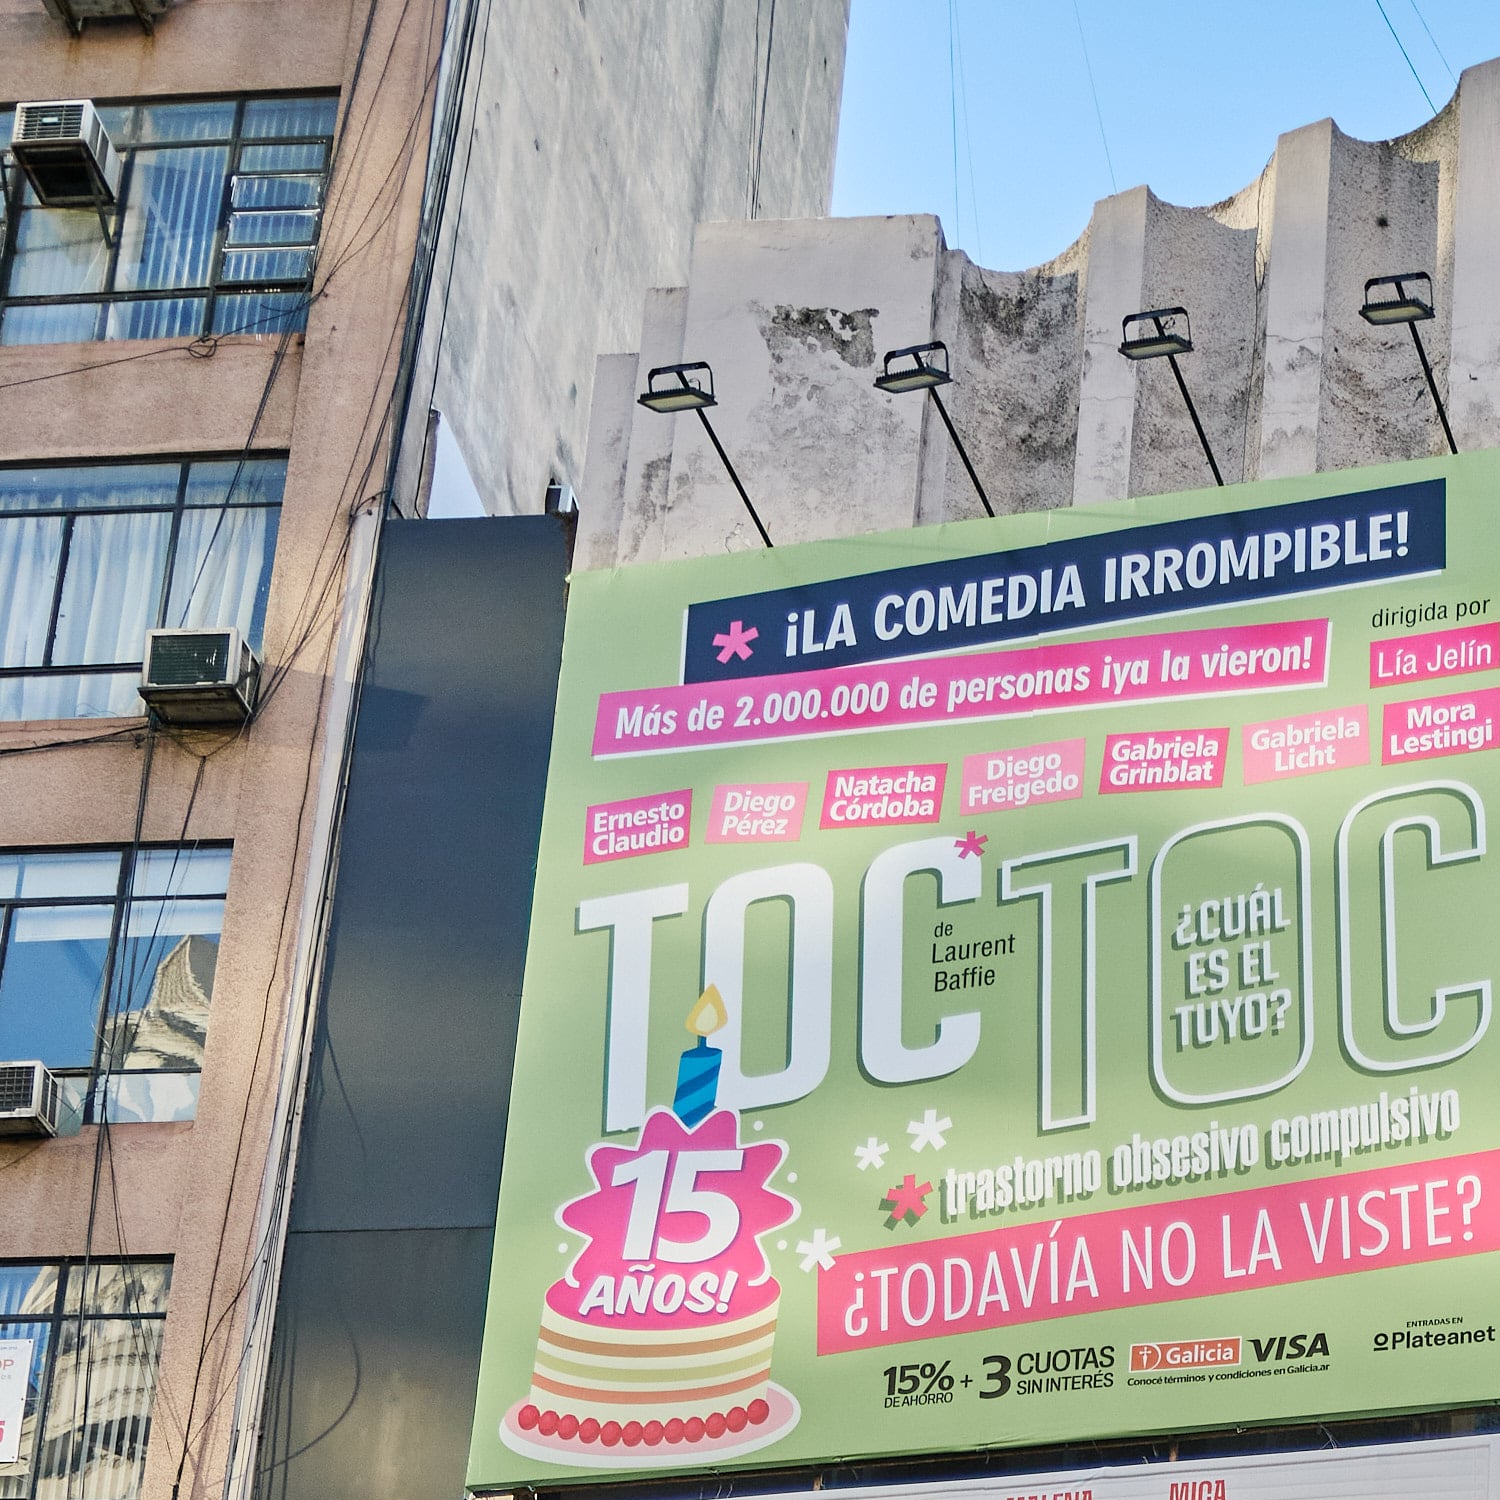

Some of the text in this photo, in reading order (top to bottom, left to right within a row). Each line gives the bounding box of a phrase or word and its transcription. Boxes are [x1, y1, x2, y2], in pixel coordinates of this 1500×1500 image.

[785, 512, 1410, 658] ¡LA COMEDIA IRROMPIBLE!
[1371, 600, 1490, 628] dirigida por
[1378, 639, 1492, 678] Lía Jelín
[615, 637, 1311, 739] Más de 2.000.000 de personas ¡ya la vieron!
[1407, 703, 1476, 729] Mora
[1111, 737, 1218, 760] Gabriela
[1251, 718, 1360, 750] Gabriela
[1390, 719, 1492, 755] Lestingi
[986, 752, 1061, 783] Diego
[1110, 761, 1213, 785] Grinblat
[1274, 744, 1336, 771] Licht
[835, 773, 936, 798] Natacha
[968, 770, 1079, 808] Freigedo
[594, 800, 685, 834] Ernesto
[723, 791, 795, 814] Diego
[830, 799, 934, 822] Córdoba
[593, 824, 685, 857] Claudio
[721, 815, 787, 836] Pérez
[1174, 885, 1292, 950] ¿CUÁL
[576, 780, 1492, 1134] TOC TOC
[932, 933, 1015, 963] Laurent
[933, 964, 996, 992] Baffie
[1187, 941, 1281, 993] ES EL
[1174, 989, 1292, 1049] TUYO?
[944, 1090, 1459, 1215] trastorno obsesivo compulsivo
[609, 1149, 743, 1263] 15
[843, 1175, 1483, 1338] ¿TODAVÍA NO LA VISTE?
[579, 1271, 735, 1316] AÑOS!
[1166, 1334, 1330, 1365] Galicia VISA
